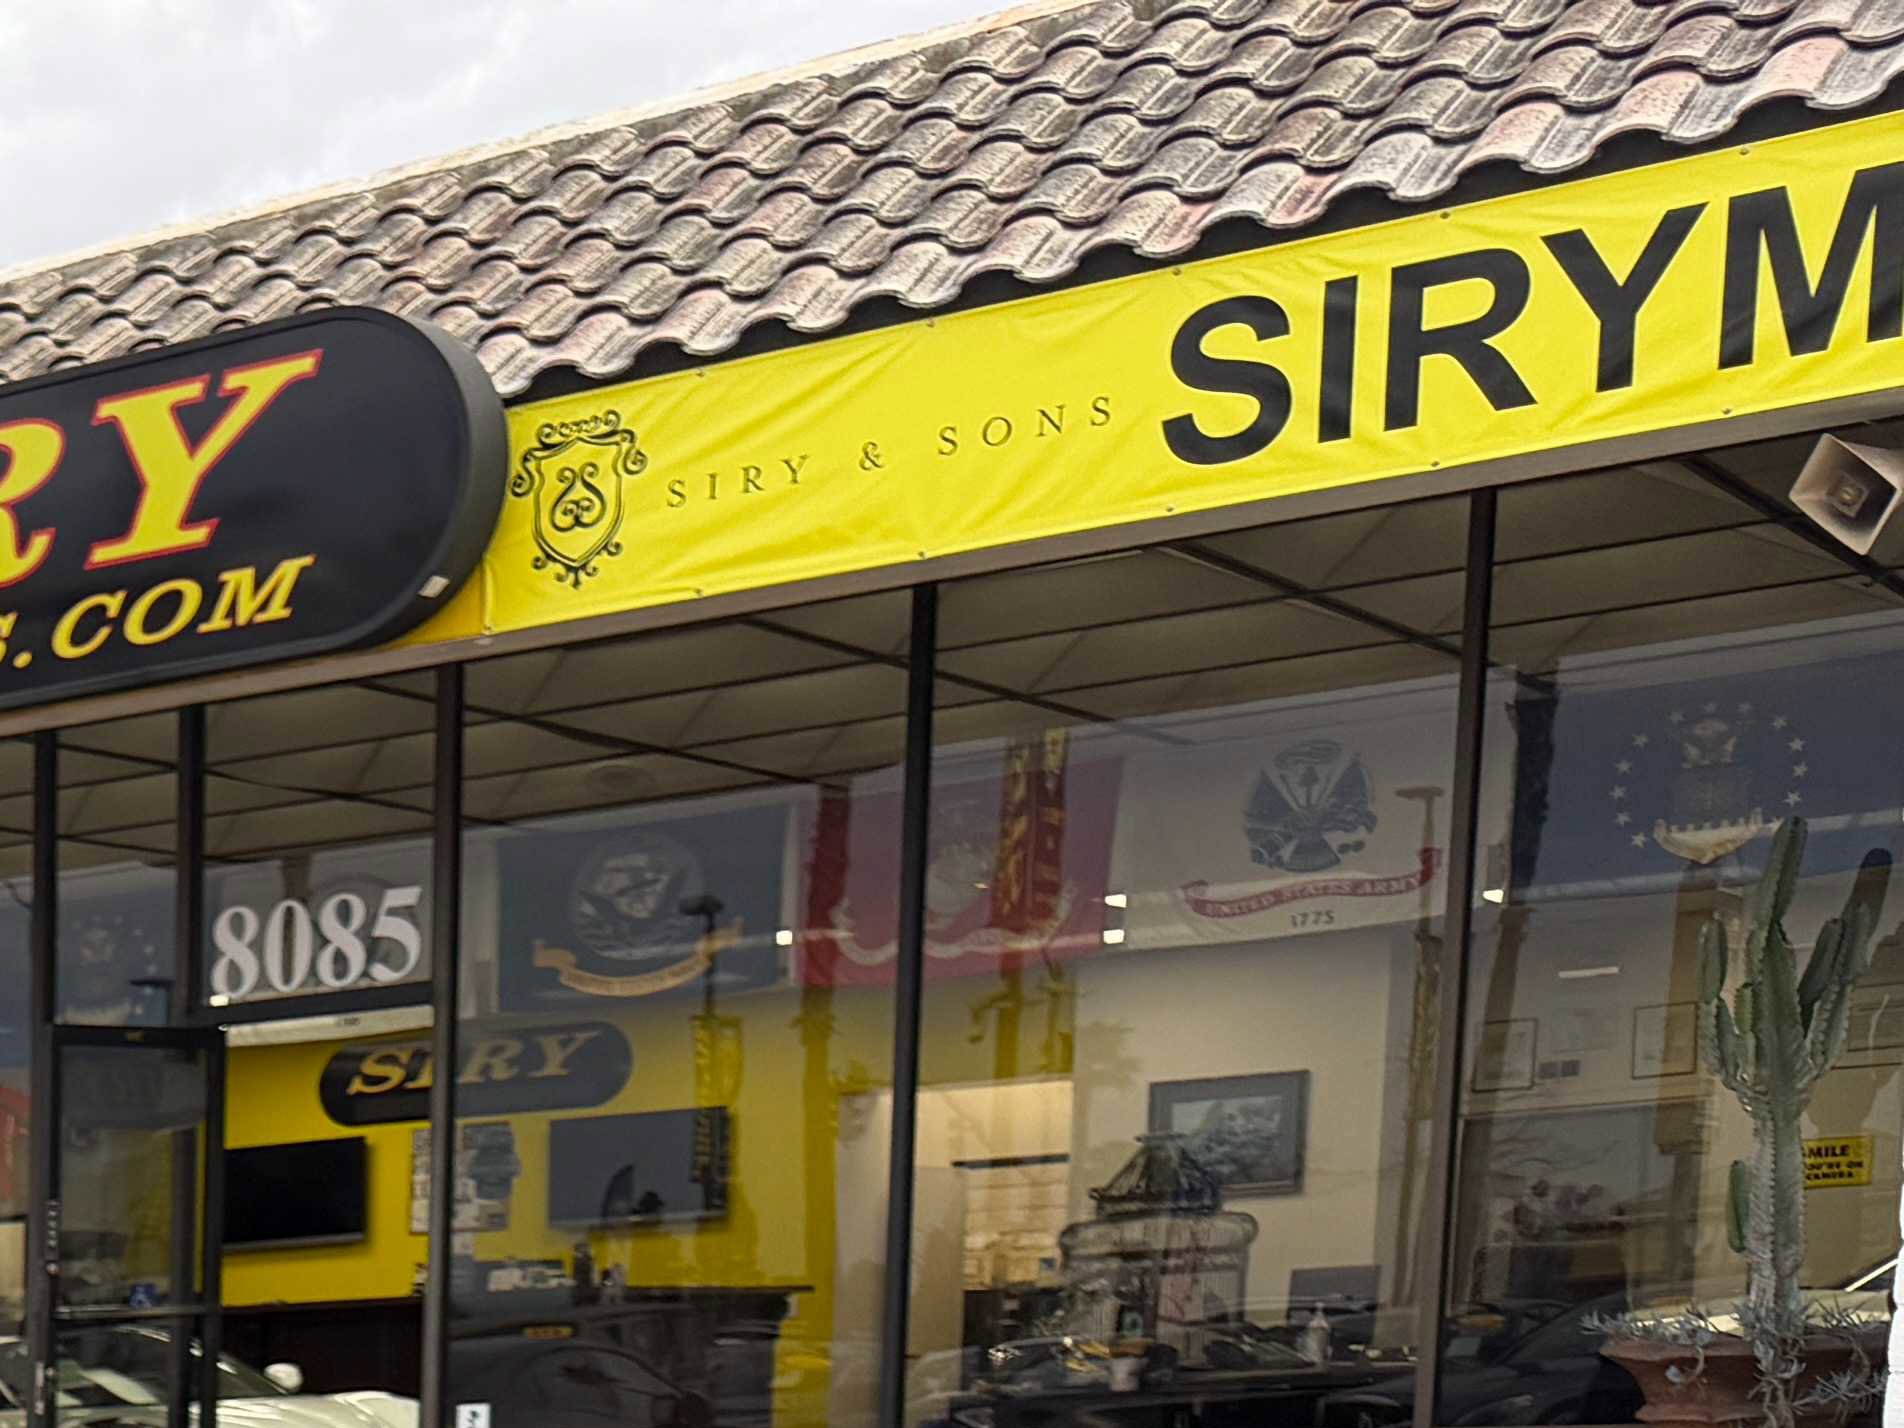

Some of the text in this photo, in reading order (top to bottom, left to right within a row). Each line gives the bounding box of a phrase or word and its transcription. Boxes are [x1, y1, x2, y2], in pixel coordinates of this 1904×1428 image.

[1161, 160, 1904, 468] SIRYM
[664, 394, 1117, 511] SIRY & SONS
[209, 885, 423, 1000] 8085
[1290, 909, 1336, 928] 1775
[345, 1028, 602, 1097] SIRY
